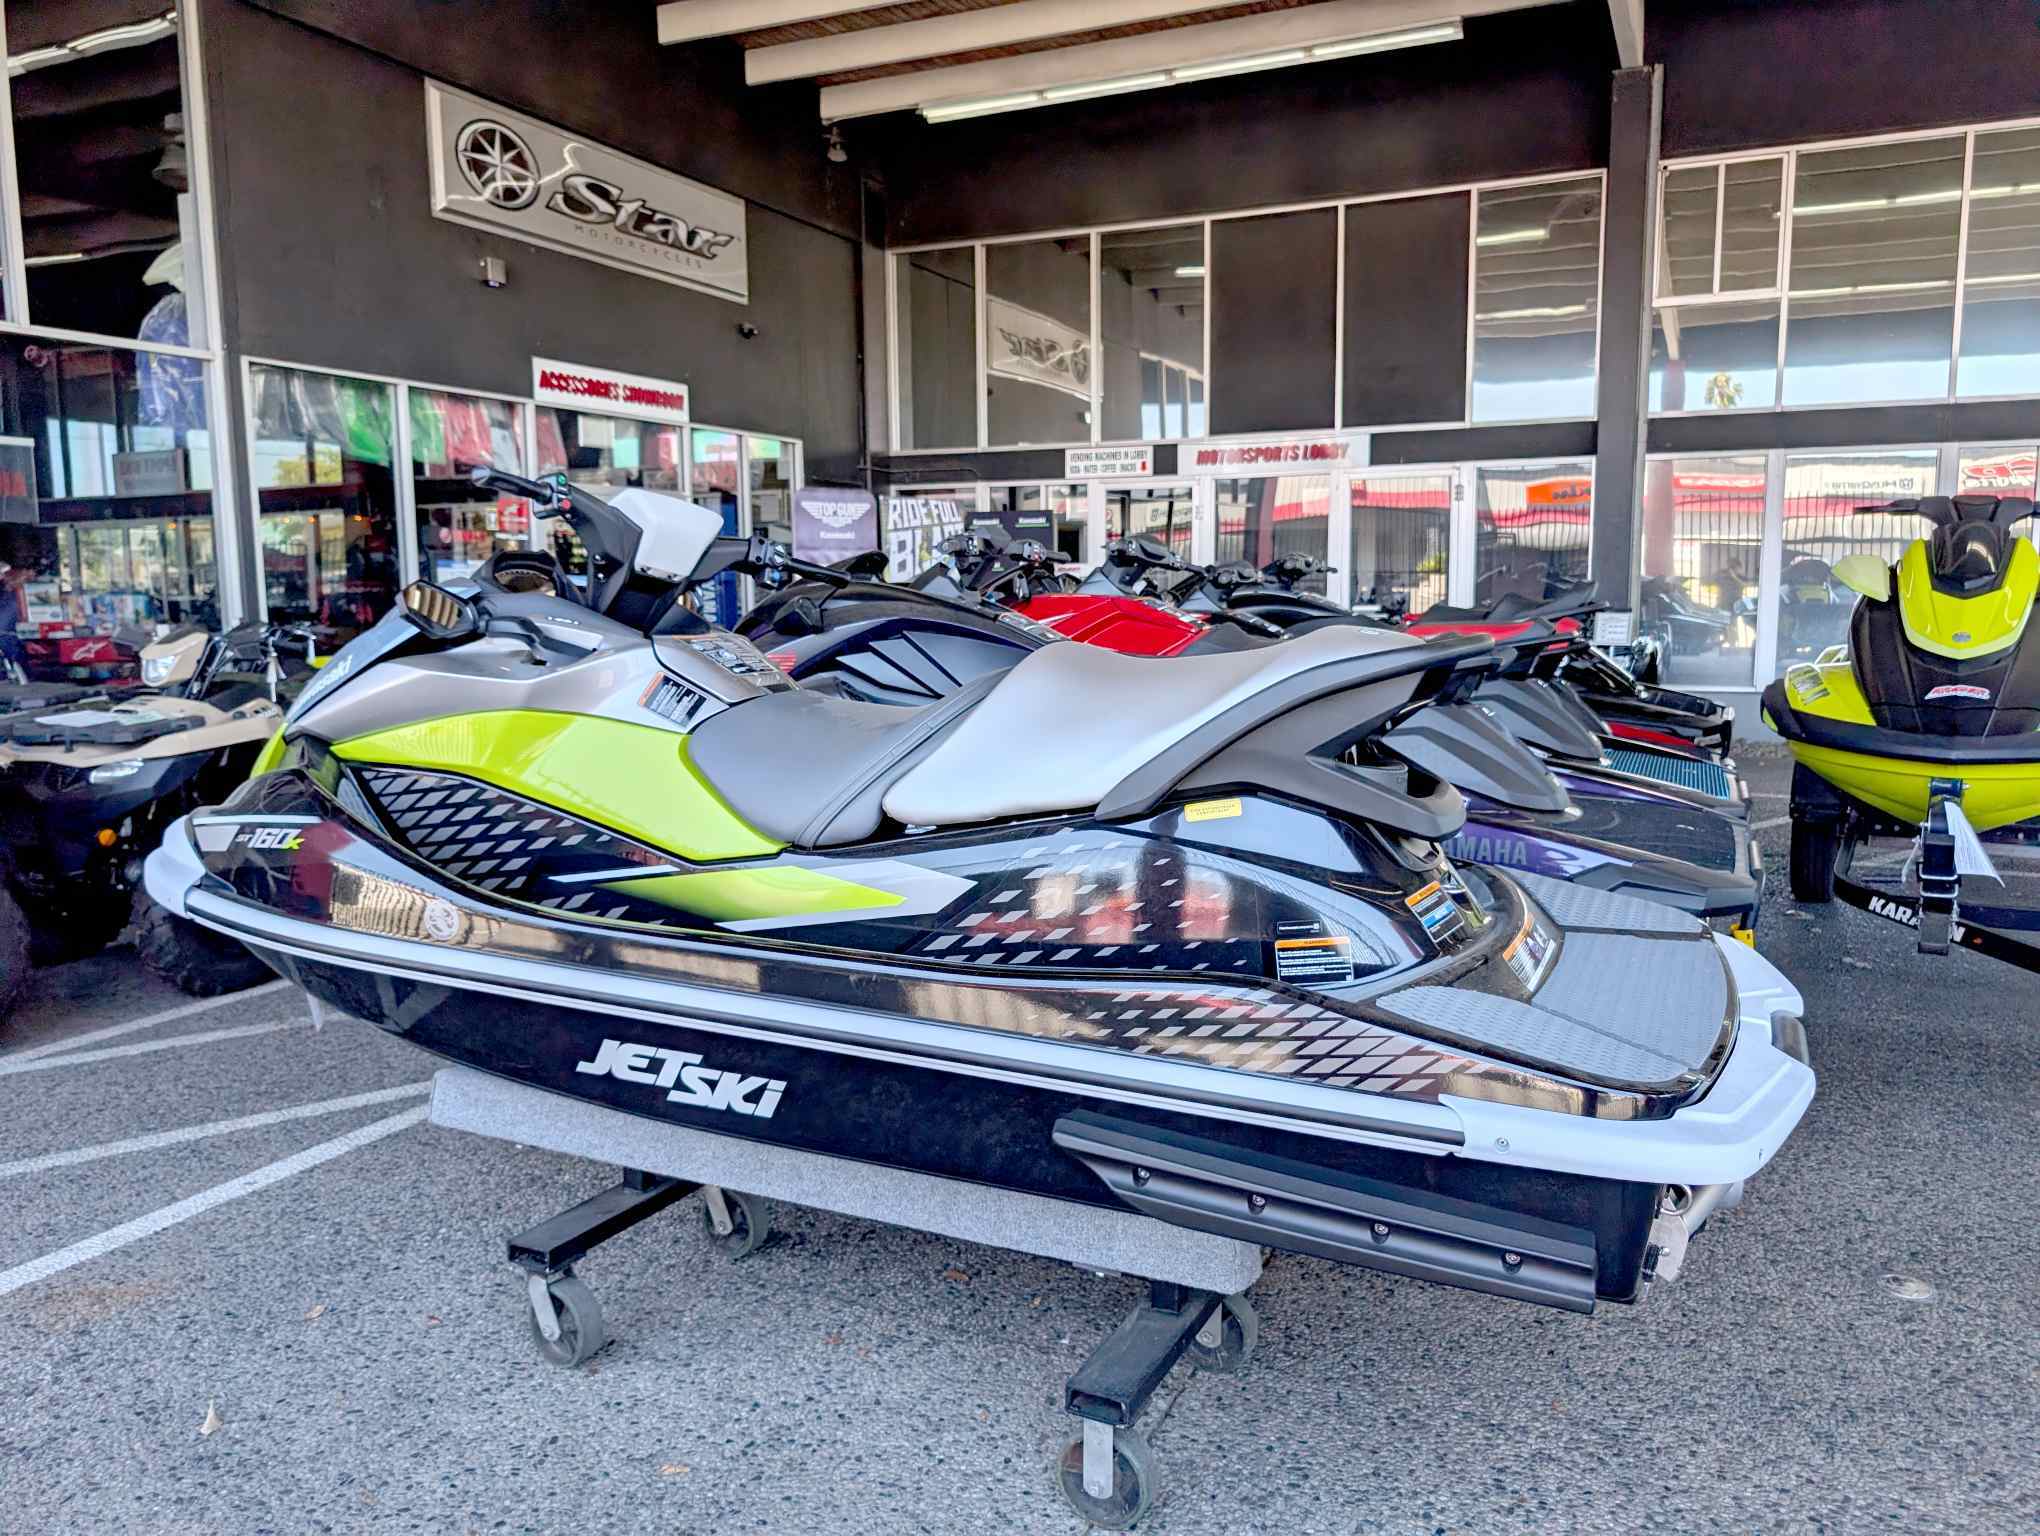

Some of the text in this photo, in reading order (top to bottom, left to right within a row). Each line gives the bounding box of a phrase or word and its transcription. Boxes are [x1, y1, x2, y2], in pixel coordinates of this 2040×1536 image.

[546, 173, 734, 260] Star
[1196, 444, 1299, 465] MOTORSPORTS
[888, 499, 961, 530] RIDE FULL
